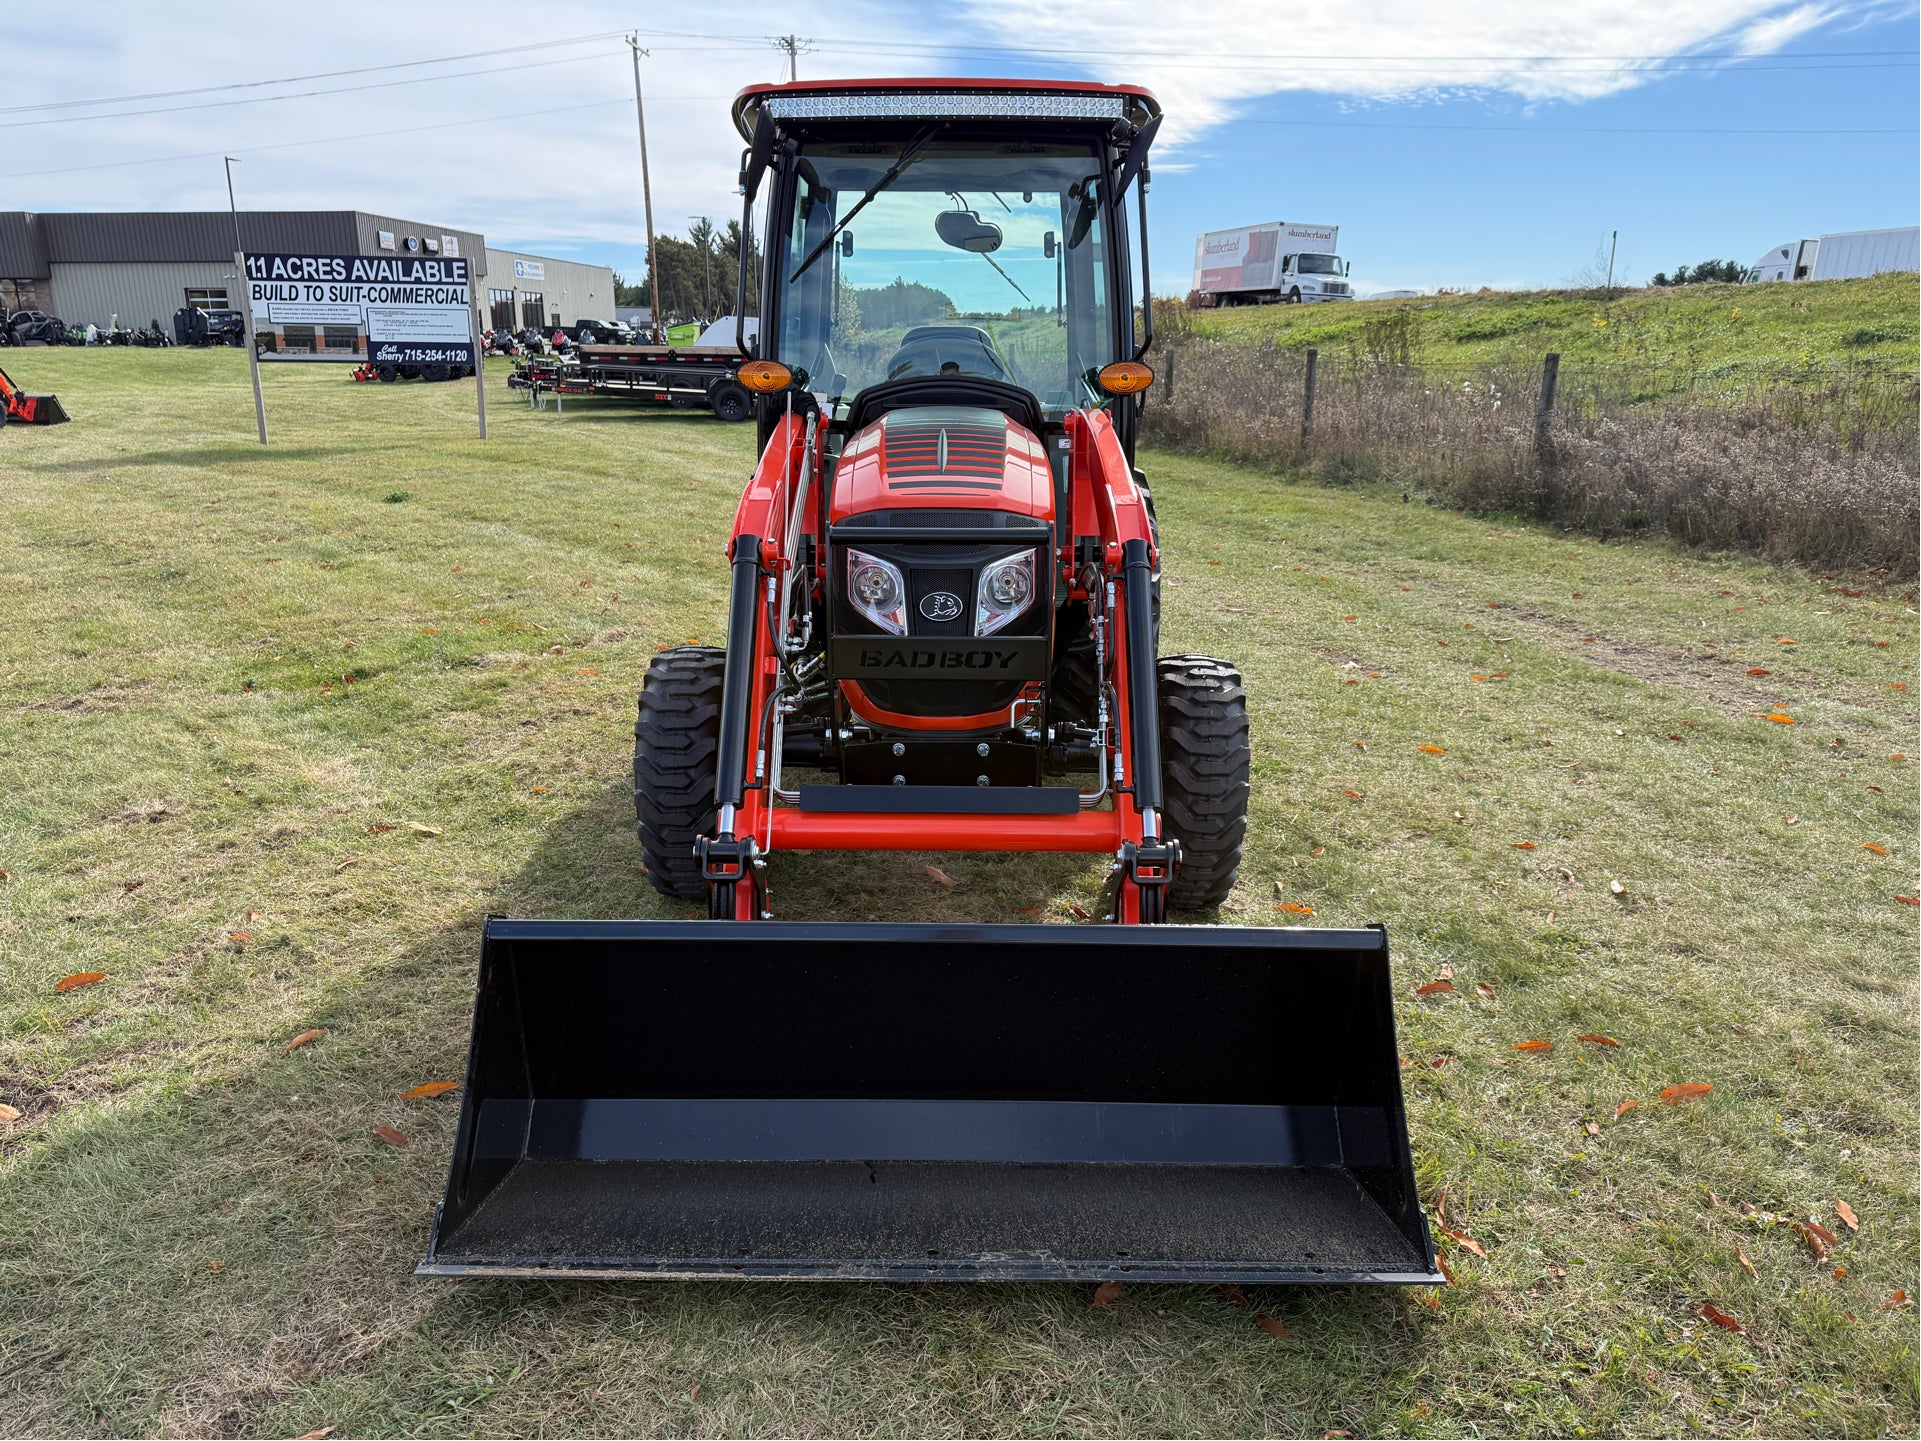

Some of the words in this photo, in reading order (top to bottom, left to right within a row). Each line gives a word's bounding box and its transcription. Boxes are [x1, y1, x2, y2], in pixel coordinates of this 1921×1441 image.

[1288, 229, 1331, 239] slumberland
[271, 257, 347, 281] ACRES
[351, 259, 467, 283] AVAILABLE
[252, 284, 299, 302] BUILD
[303, 285, 324, 302] TO
[329, 285, 469, 305] SUIT-COMMERCIAL
[376, 351, 403, 363] Sherry
[404, 349, 468, 362] 715-254-1120
[381, 344, 398, 354] Call
